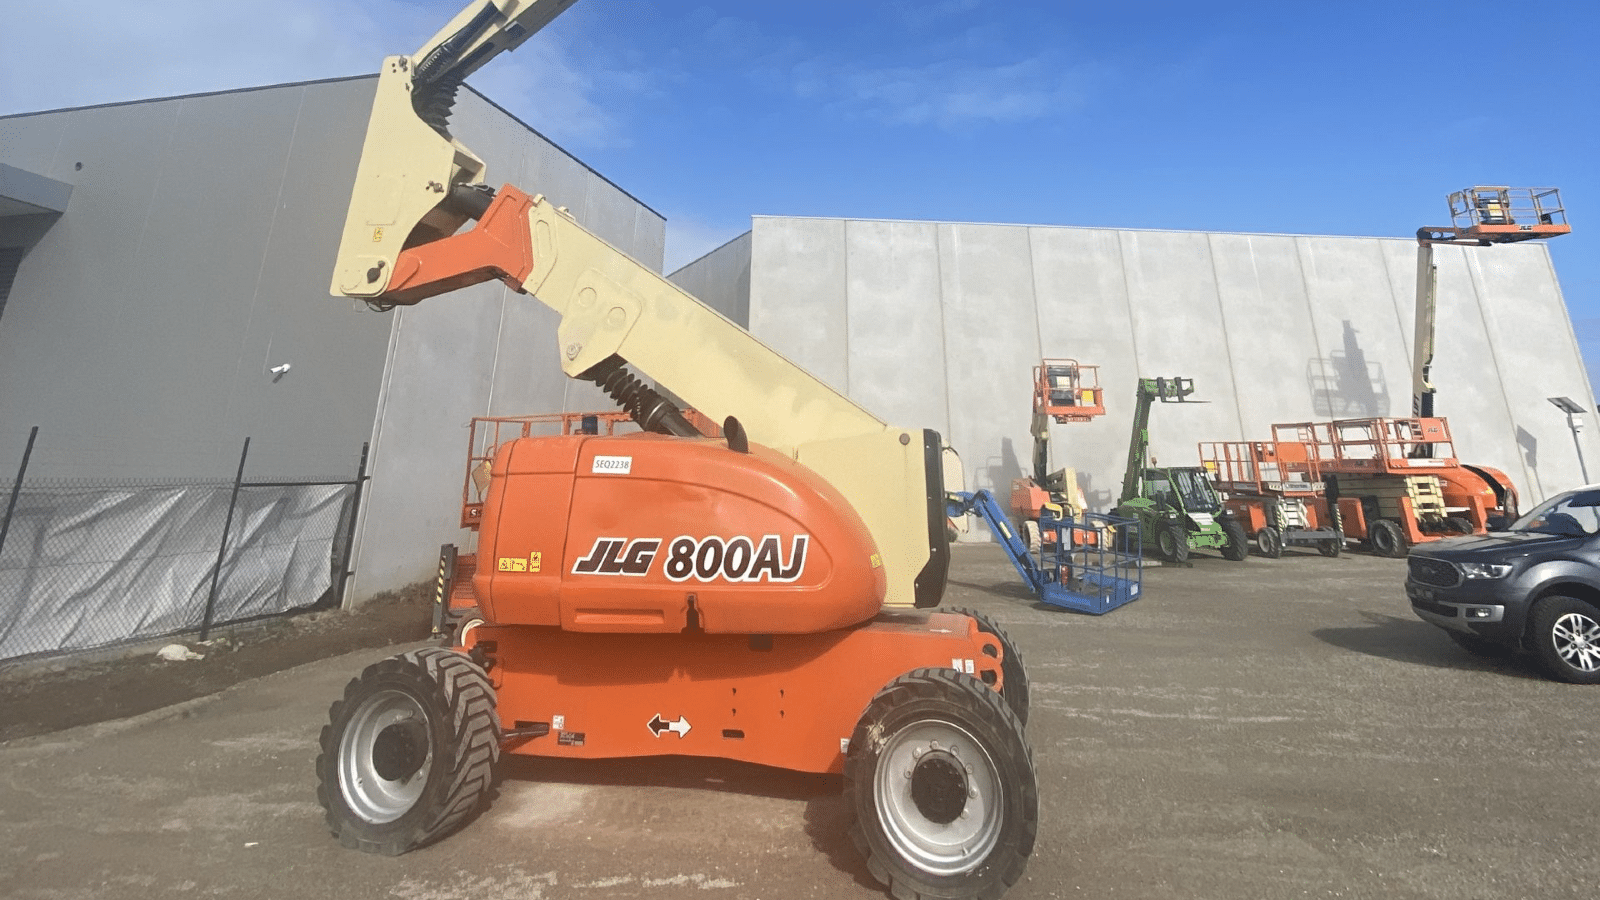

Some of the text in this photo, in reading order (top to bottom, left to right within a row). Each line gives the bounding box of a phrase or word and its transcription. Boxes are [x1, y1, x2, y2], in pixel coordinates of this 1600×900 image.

[595, 459, 630, 470] SEQ2238
[571, 534, 809, 582] JLG 800AJ
